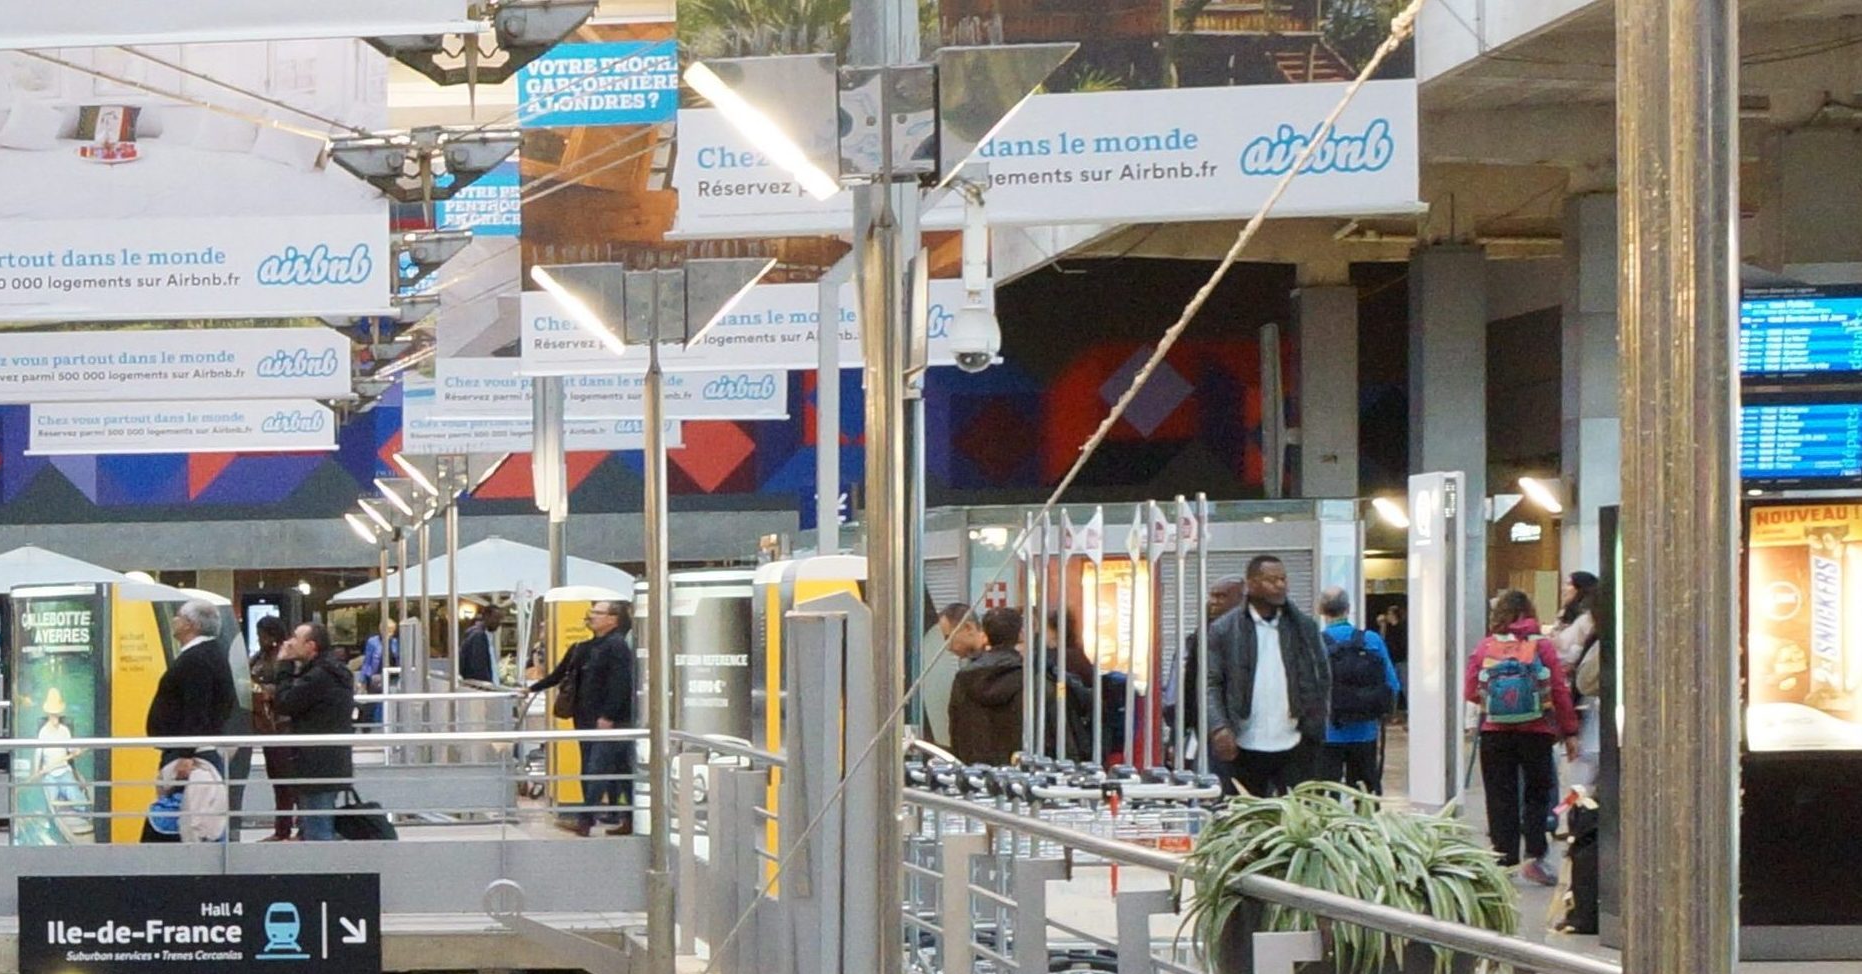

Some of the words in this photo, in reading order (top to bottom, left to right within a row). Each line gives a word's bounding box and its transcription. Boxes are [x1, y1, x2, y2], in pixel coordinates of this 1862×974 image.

[527, 57, 597, 75] VOTRE
[599, 54, 678, 73] PROCH
[979, 138, 1051, 157] dans
[1059, 130, 1086, 154] le
[1093, 126, 1199, 152] monde
[1240, 118, 1394, 178] airbnb
[698, 178, 791, 198] Réservez
[988, 169, 1073, 190] ements
[1080, 166, 1113, 183] sur
[1120, 161, 1217, 182] Airbnb.fr
[63, 249, 115, 267] dans
[122, 249, 141, 265] le
[148, 247, 225, 265] monde
[256, 243, 373, 287] airbnb
[12, 277, 43, 290] 000
[49, 275, 132, 293] logements
[138, 278, 161, 288] sur
[168, 273, 242, 287] Airbnb.fr
[768, 309, 784, 323] le
[534, 337, 595, 350] Réservez
[704, 333, 776, 347] logements
[781, 334, 801, 343] sur
[11, 356, 48, 367] vous
[53, 353, 115, 369] partout
[118, 352, 157, 365] dans
[161, 351, 175, 364] le
[180, 351, 235, 364] monde
[257, 348, 338, 378] airbnb
[22, 371, 55, 383] parmi
[58, 371, 80, 381] 500
[84, 371, 106, 381] 000
[109, 369, 168, 382] logements
[172, 371, 190, 379] sur
[193, 367, 245, 379] Airbnb.fr
[444, 376, 479, 388] Chez
[484, 377, 518, 388] vous
[579, 375, 613, 387] dans
[617, 374, 631, 386] le
[703, 375, 775, 400] airbnb
[444, 392, 490, 402] Réservez
[570, 391, 623, 402] logements
[38, 414, 67, 425] Chez
[71, 416, 100, 425] vous
[103, 413, 150, 427] partout
[154, 412, 184, 424] dans
[202, 411, 245, 422] monde
[261, 410, 324, 433] airbnb
[1756, 506, 1847, 526] NOUVEAU
[201, 902, 232, 917] Hall
[233, 903, 243, 916] 4
[48, 919, 242, 944] Ile-de-France
[66, 950, 113, 962] Suburban
[114, 951, 152, 962] services
[162, 950, 193, 961] Trenes
